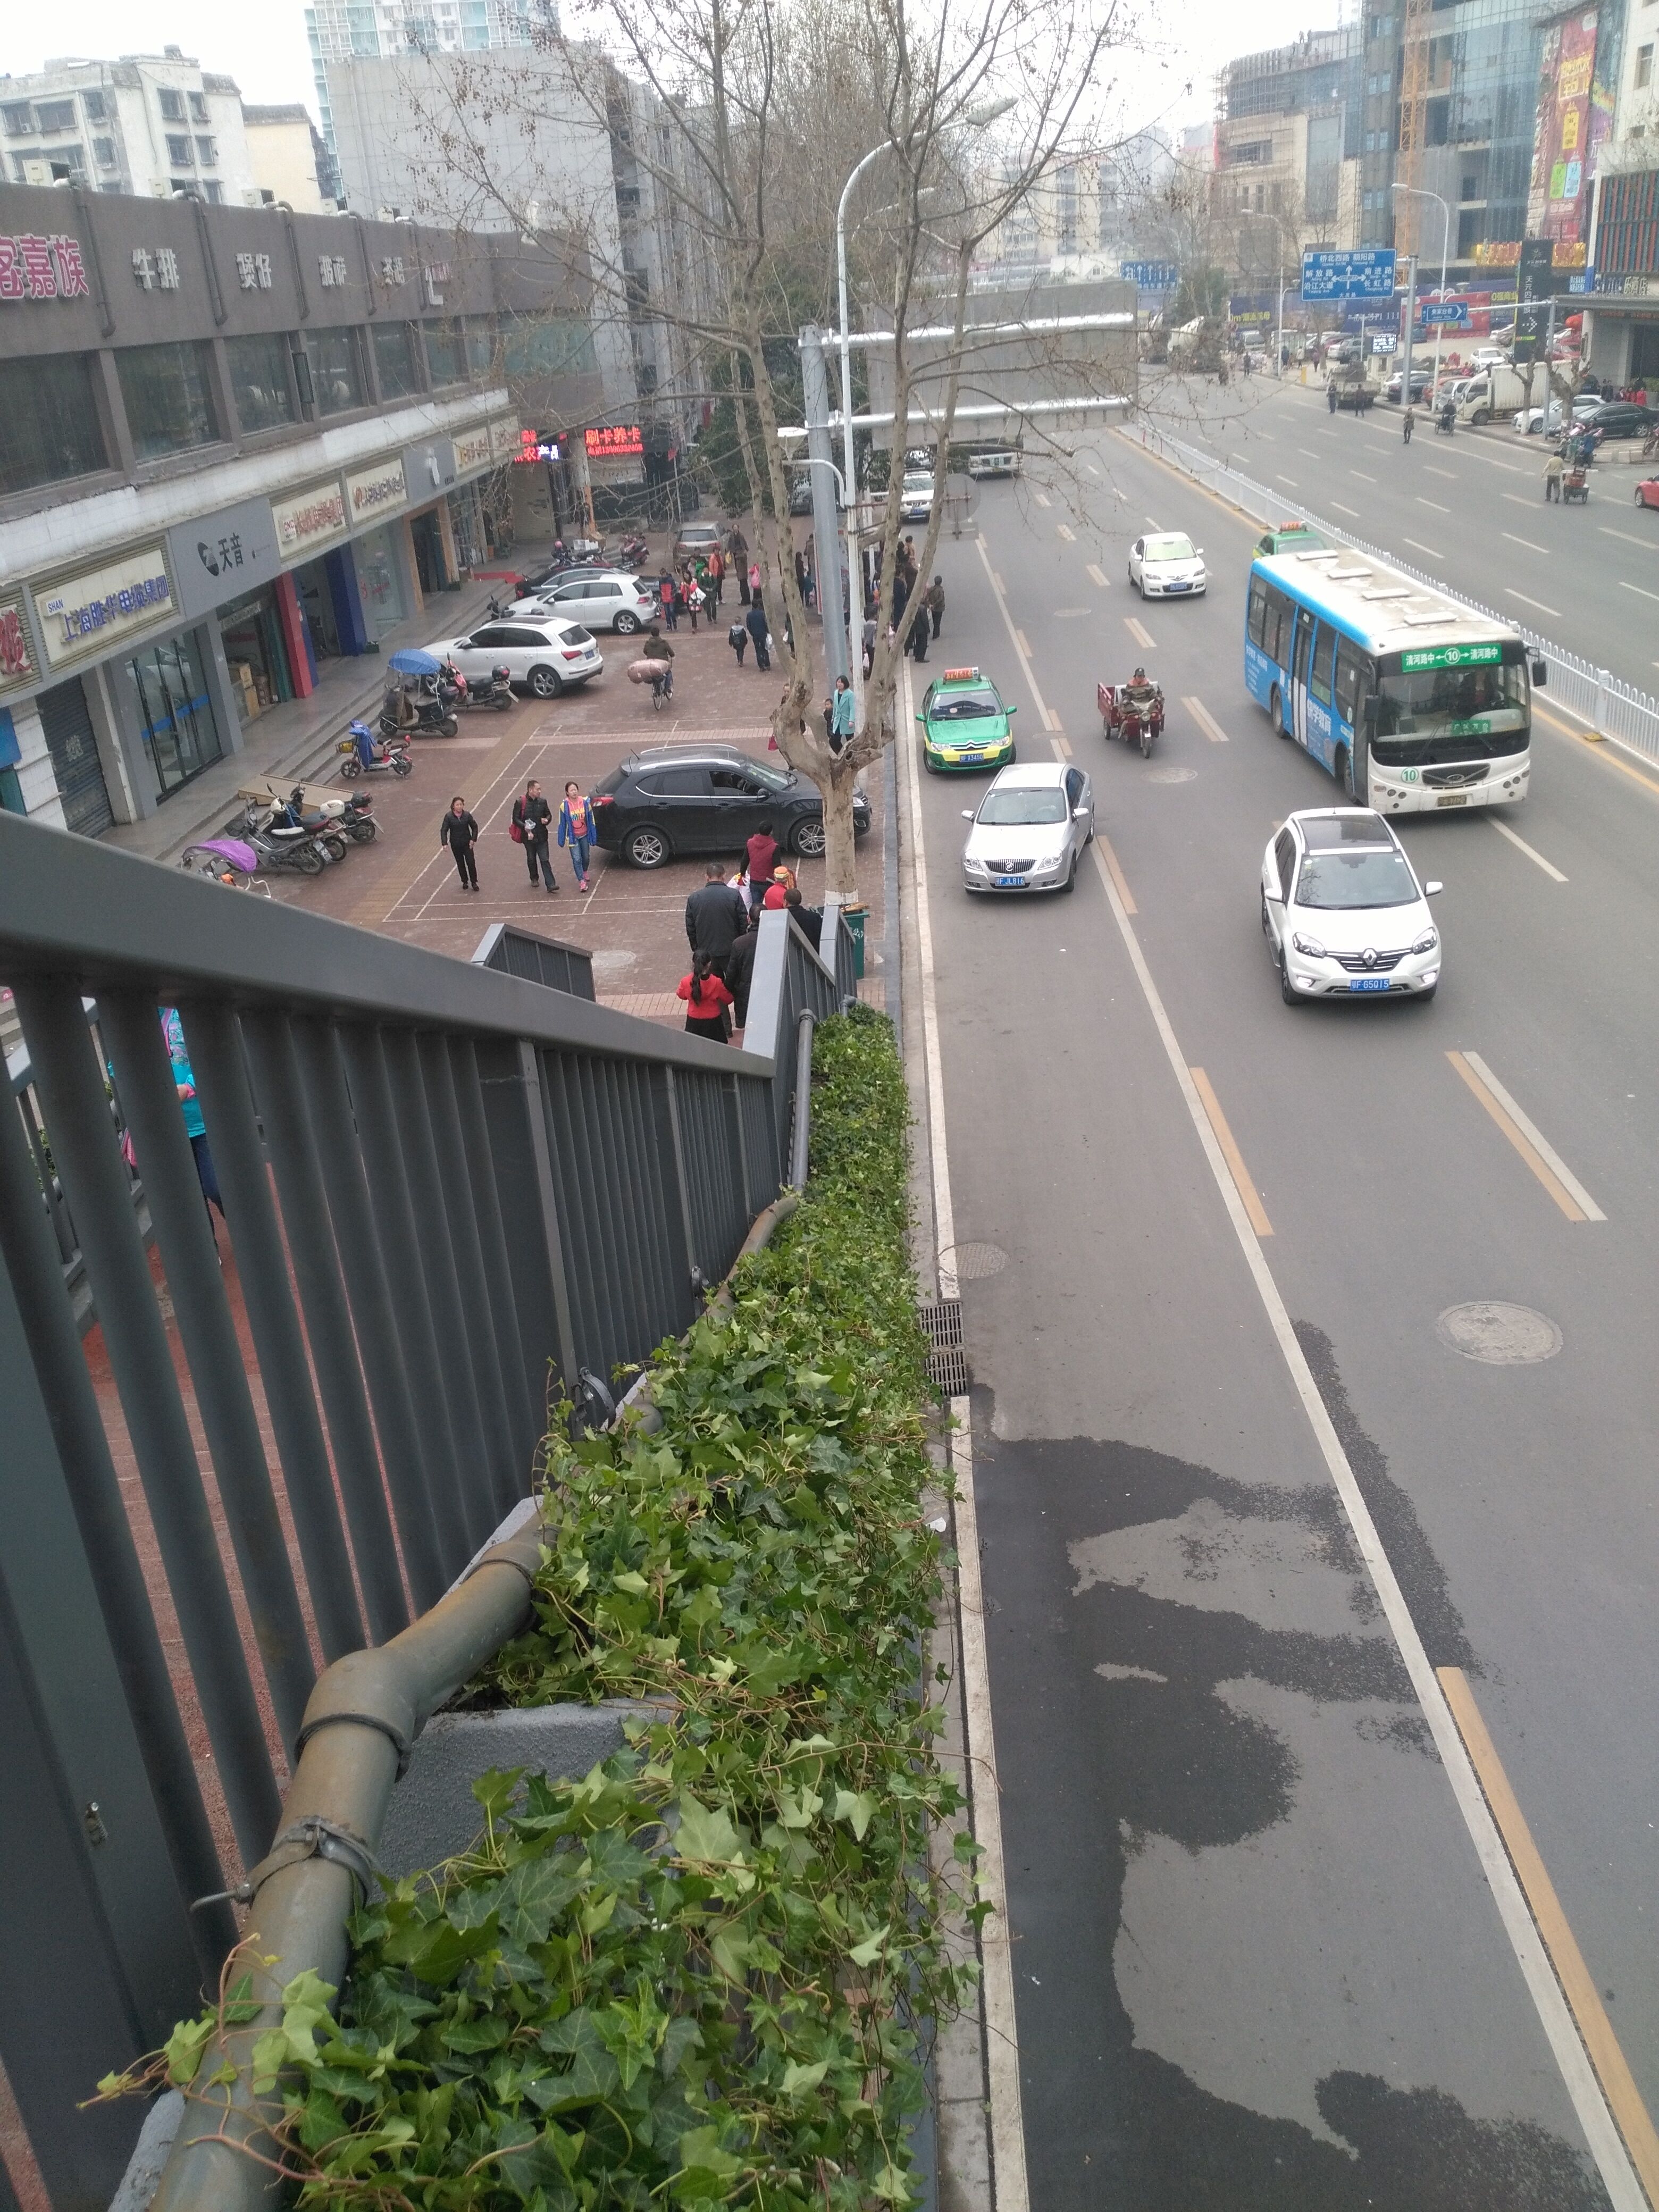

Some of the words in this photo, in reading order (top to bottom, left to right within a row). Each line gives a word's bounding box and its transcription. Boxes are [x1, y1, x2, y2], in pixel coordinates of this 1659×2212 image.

[132, 248, 180, 289] 牛排
[236, 253, 272, 288] 煲仔
[1305, 269, 1334, 278] 解放路
[1364, 266, 1392, 275] 前进路
[585, 426, 641, 446] 刷卡养卡
[218, 532, 244, 572] 天音
[48, 599, 64, 613] SHAN
[64, 575, 169, 641] 上海胜华电缆集团
[1406, 653, 1435, 666] 清河路中
[1447, 651, 1458, 660] 10
[1470, 648, 1498, 660] 清河路中
[1403, 770, 1416, 781] 10
